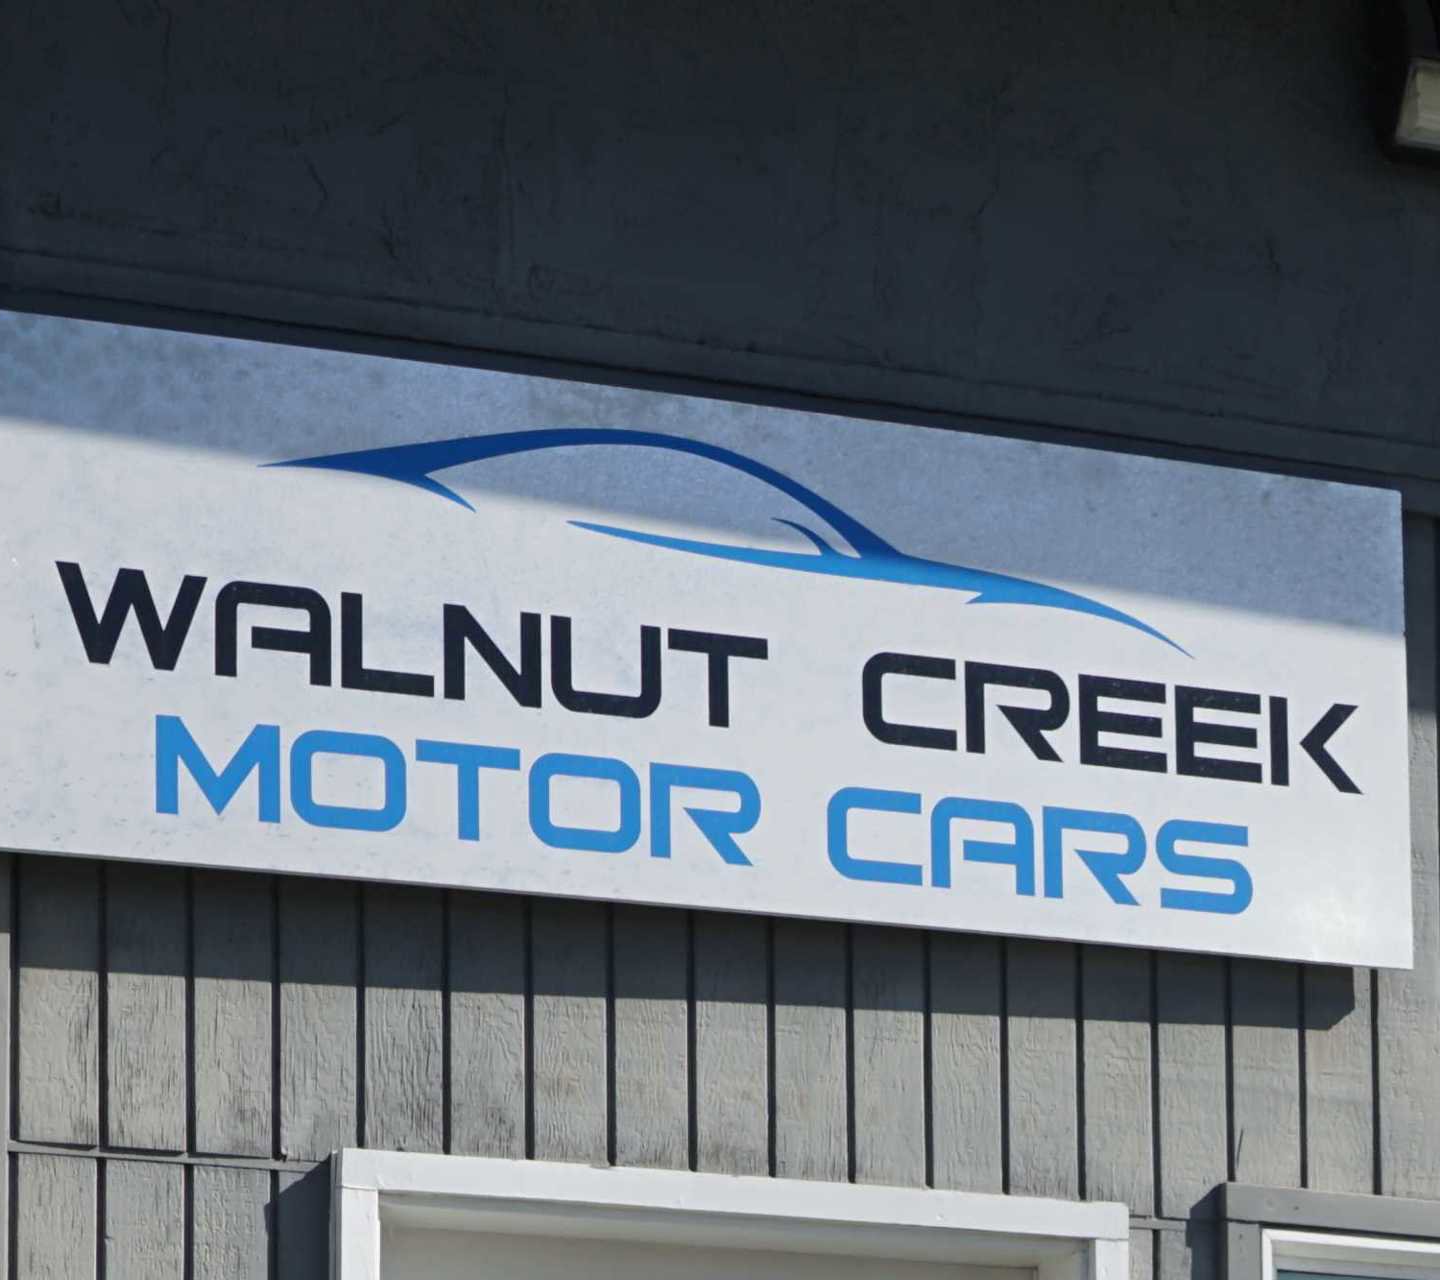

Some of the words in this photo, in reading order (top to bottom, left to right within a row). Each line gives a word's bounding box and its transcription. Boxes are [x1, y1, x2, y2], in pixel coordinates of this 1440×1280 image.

[55, 560, 768, 728] WALNUT
[860, 651, 1364, 795] CREEK
[155, 714, 761, 867] MOTOR
[826, 786, 1253, 915] CARS
